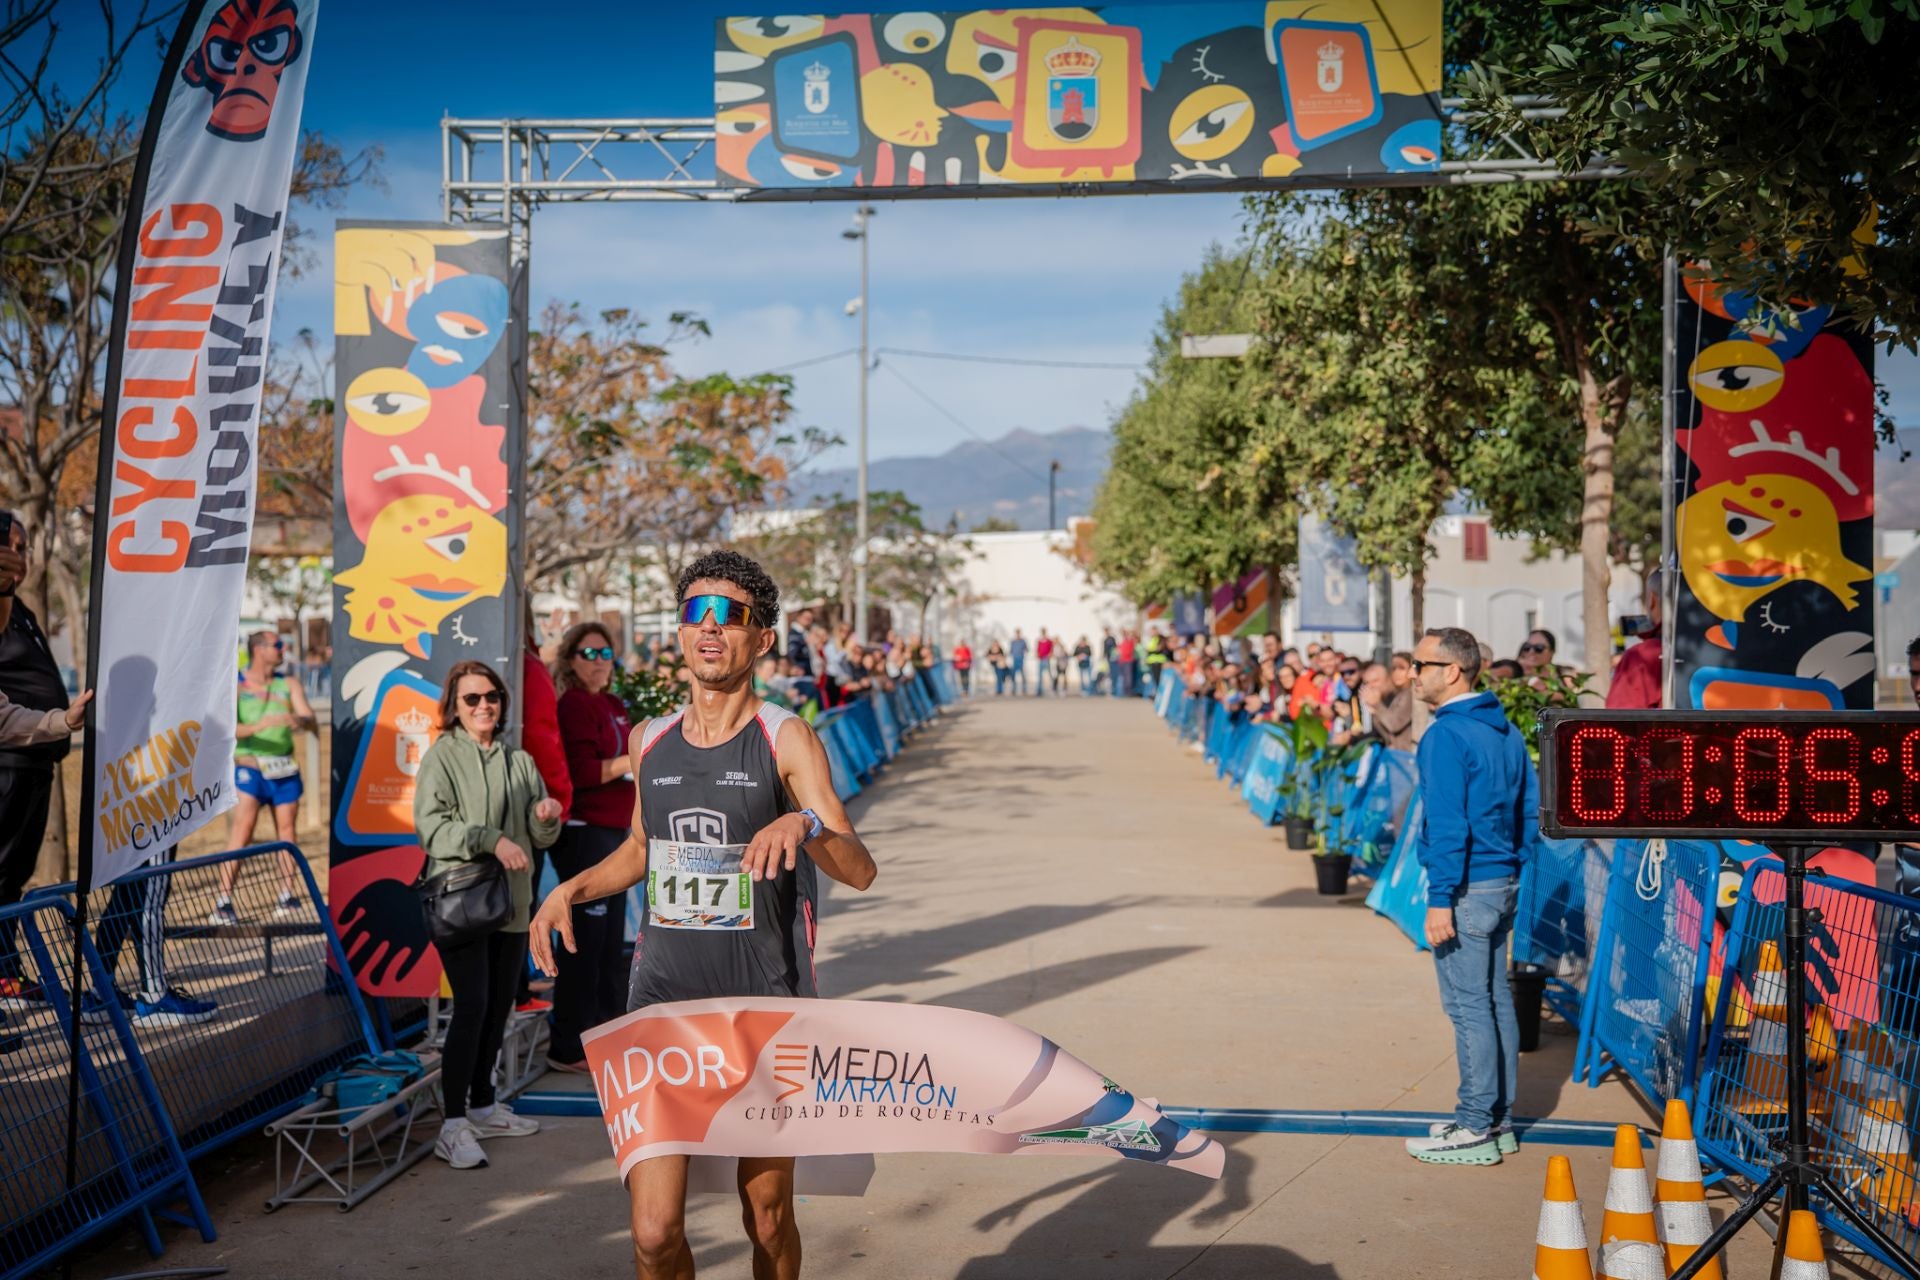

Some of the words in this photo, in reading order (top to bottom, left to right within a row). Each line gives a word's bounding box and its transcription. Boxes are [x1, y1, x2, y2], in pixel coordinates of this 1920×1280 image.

[106, 203, 223, 573] CYCLING
[677, 847, 714, 860] MEDIA
[663, 876, 729, 906] 117
[811, 1045, 935, 1087] MEDIA
[745, 1104, 825, 1121] CIUDAD
[838, 1104, 865, 1118] DE
[877, 1105, 995, 1126] ROQUETAS
